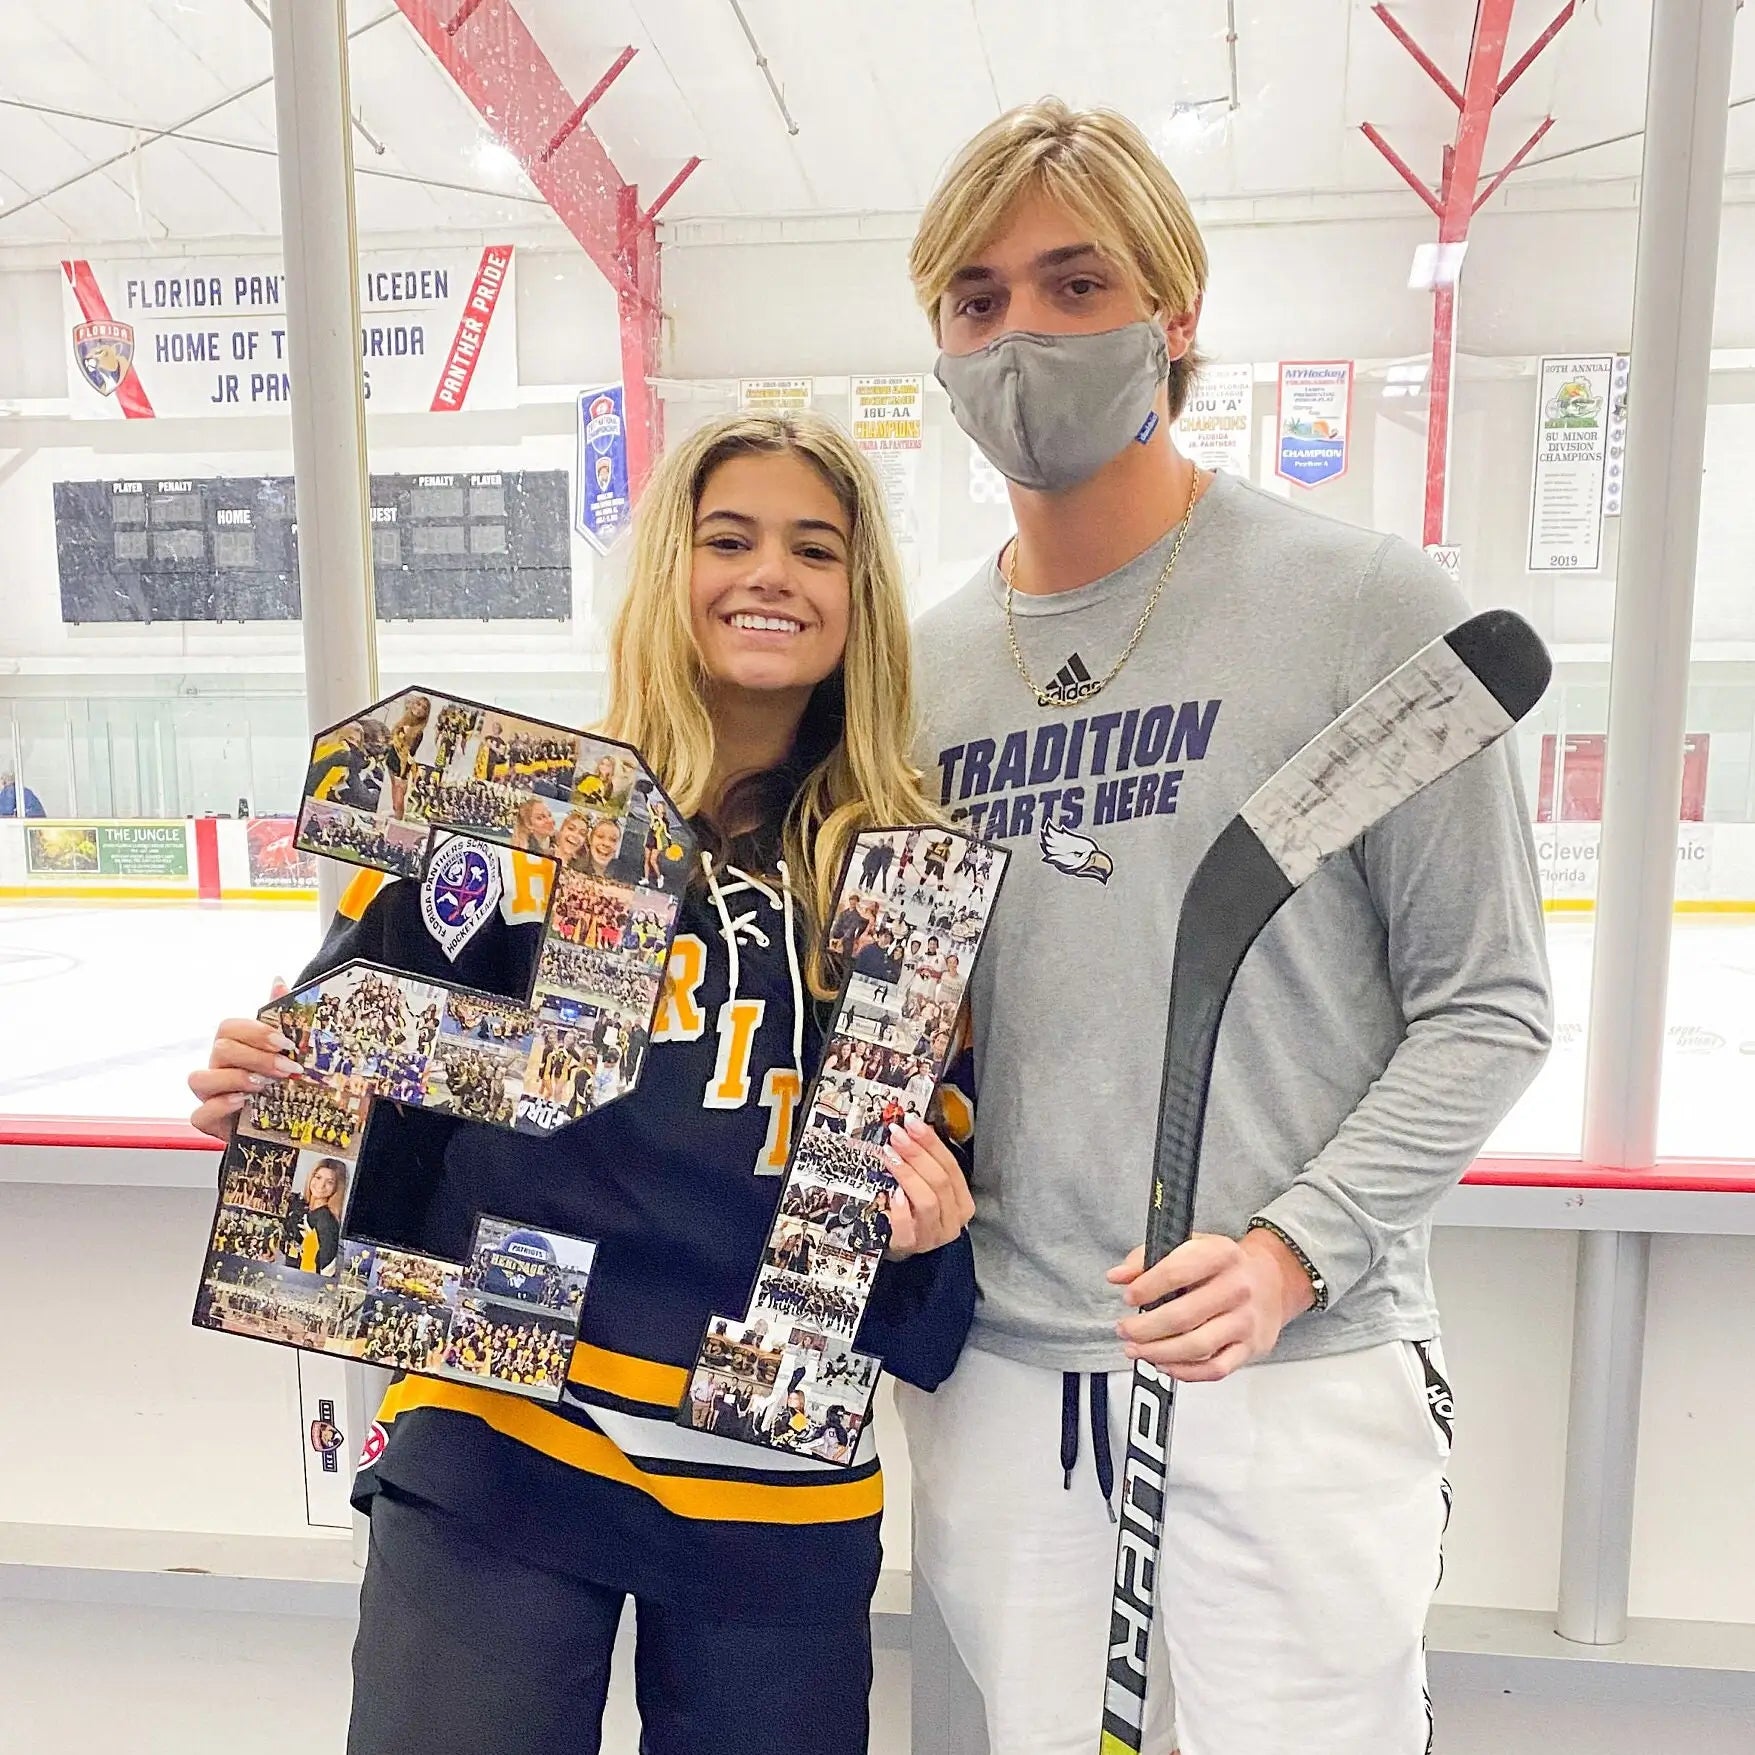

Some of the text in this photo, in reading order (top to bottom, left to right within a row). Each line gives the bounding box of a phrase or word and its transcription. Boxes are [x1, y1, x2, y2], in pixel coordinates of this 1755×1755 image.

[126, 270, 449, 309] FLORIDA PAN ICEDEN
[79, 325, 128, 340] FLORIDA
[439, 253, 506, 405] PANTHER PRIDE
[155, 332, 221, 363] HOME
[232, 331, 258, 361] OF
[1571, 363, 1611, 373] ANNUAL
[211, 374, 239, 403] JR
[1188, 400, 1216, 412] 10U
[854, 420, 920, 439] CHAMPIONS
[1180, 416, 1247, 432] CHAMPIONS
[1562, 431, 1599, 441] MINOR
[1282, 449, 1342, 458] CHAMPION
[1548, 442, 1595, 452] DIVISION
[1539, 452, 1603, 462] CHAMPIONS
[113, 480, 193, 493] PLAYER PENALTY
[418, 474, 502, 488] PENALTY PLAYER
[216, 508, 252, 526] HOME
[369, 507, 398, 522] UEST
[1550, 555, 1578, 567] 2019
[1037, 680, 1102, 707] adidas
[938, 699, 1223, 806] TRADITION
[1093, 769, 1185, 826] HERE
[105, 828, 180, 843] THE JUNGLE
[1538, 842, 1600, 860] Clevel
[425, 841, 464, 892] PANTHERS
[425, 896, 447, 938] FLORIDA
[446, 918, 475, 954] HOCKEY
